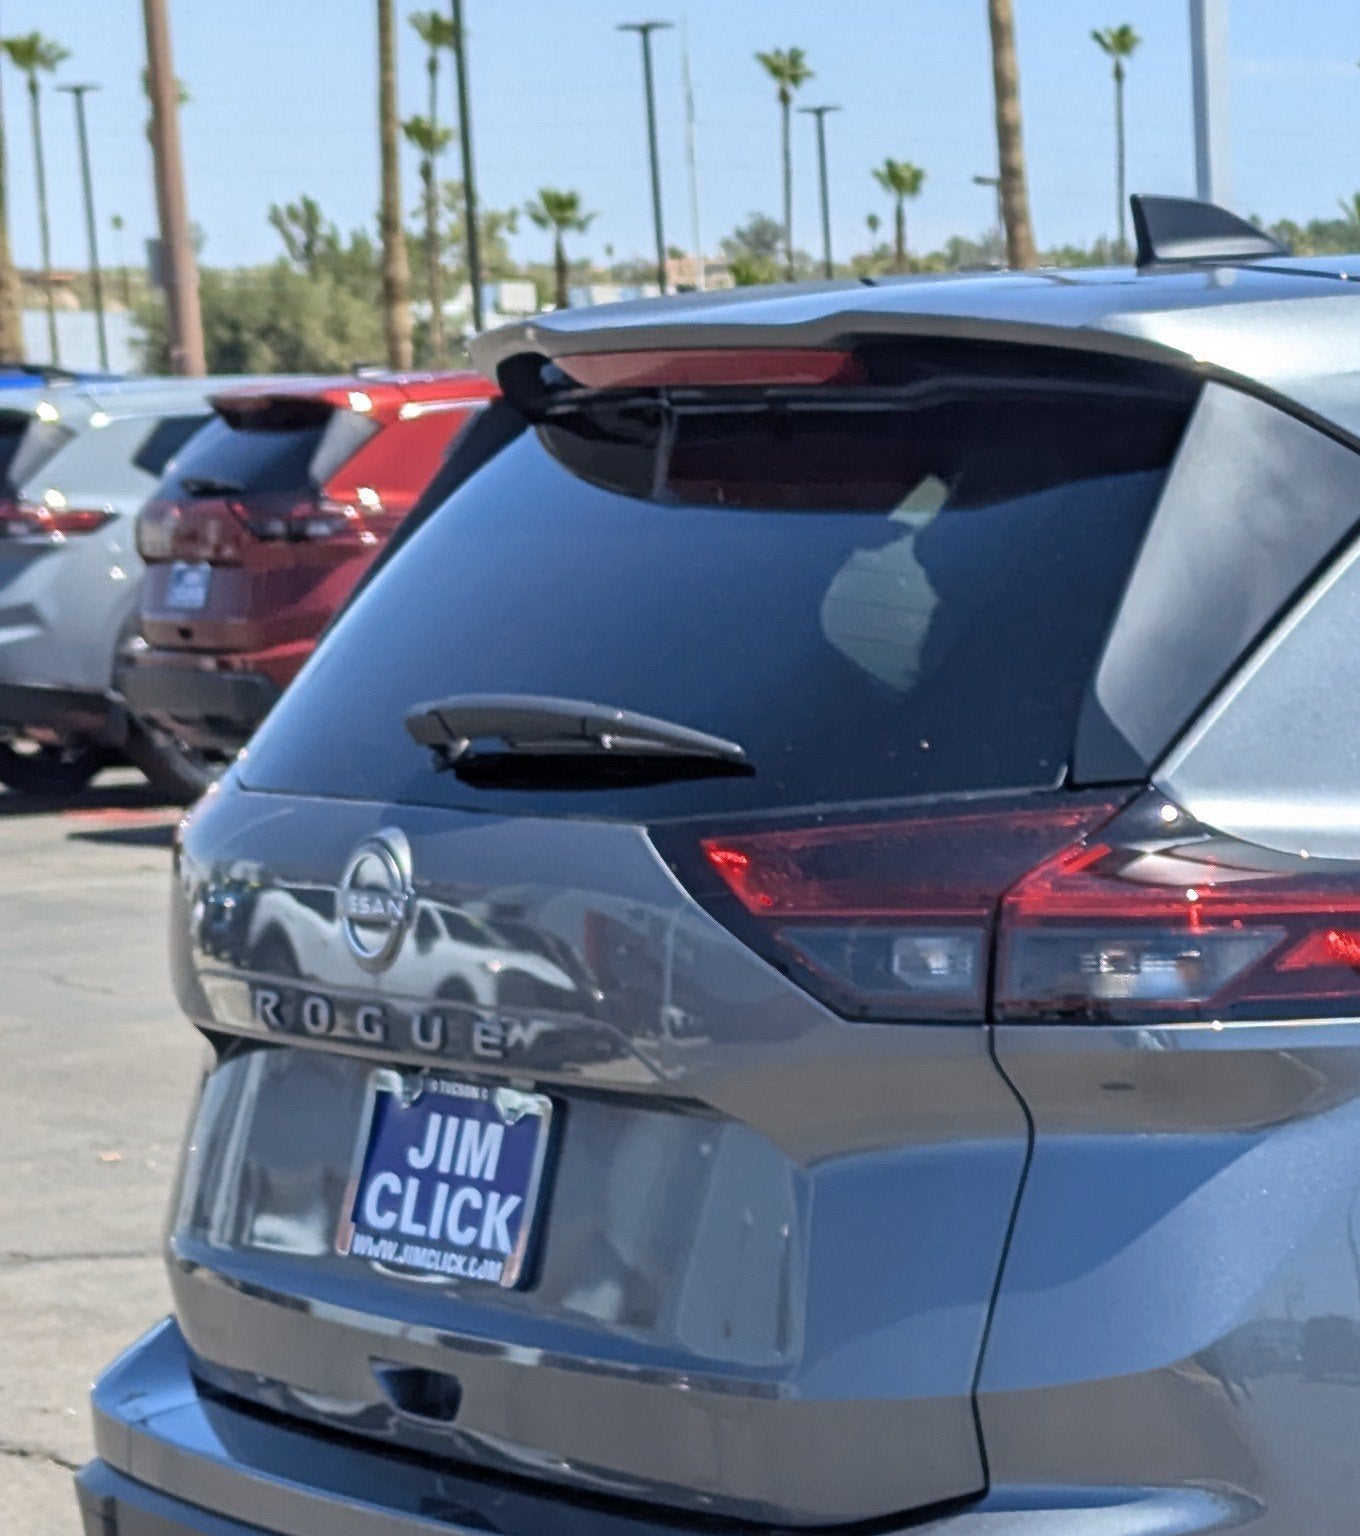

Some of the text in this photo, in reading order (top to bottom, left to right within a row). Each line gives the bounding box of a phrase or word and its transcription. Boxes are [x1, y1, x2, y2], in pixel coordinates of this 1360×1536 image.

[254, 988, 504, 1058] ROGUE
[406, 1112, 505, 1182] JIM
[364, 1171, 523, 1255] CLICK
